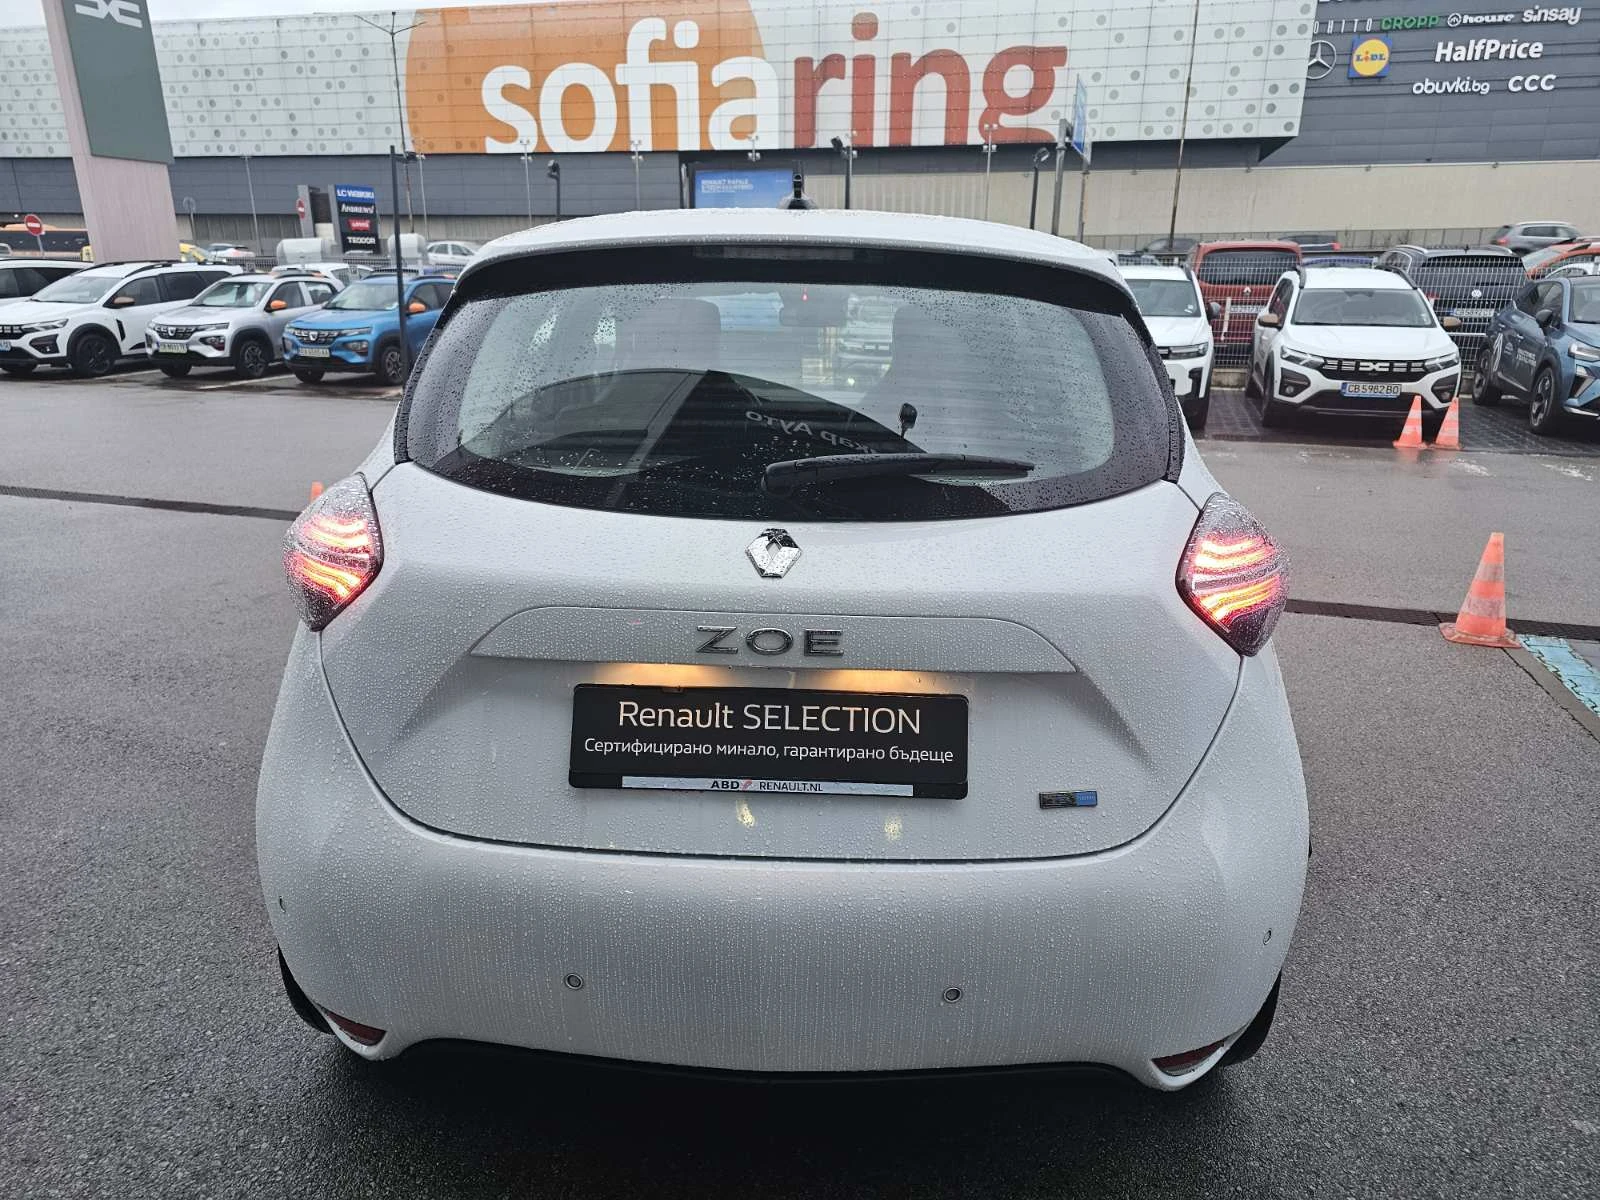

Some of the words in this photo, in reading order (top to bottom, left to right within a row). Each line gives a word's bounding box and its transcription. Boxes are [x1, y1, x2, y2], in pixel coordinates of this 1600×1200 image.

[1381, 15, 1440, 31] CROPP
[1522, 5, 1582, 25] sinsay
[1434, 38, 1544, 63] HalfPrice
[1412, 76, 1490, 95] obuvki.bg
[1508, 74, 1557, 92] CCC
[696, 625, 844, 656] ZOE
[618, 700, 734, 729] Renault
[743, 703, 921, 735] SELECTION
[584, 737, 713, 757] Сертифицирано
[716, 743, 780, 759] минало,
[784, 745, 886, 762] гарантирано
[889, 746, 954, 764] бъдеще
[710, 780, 740, 790] ABD
[759, 781, 824, 792] RENAULT.NL
